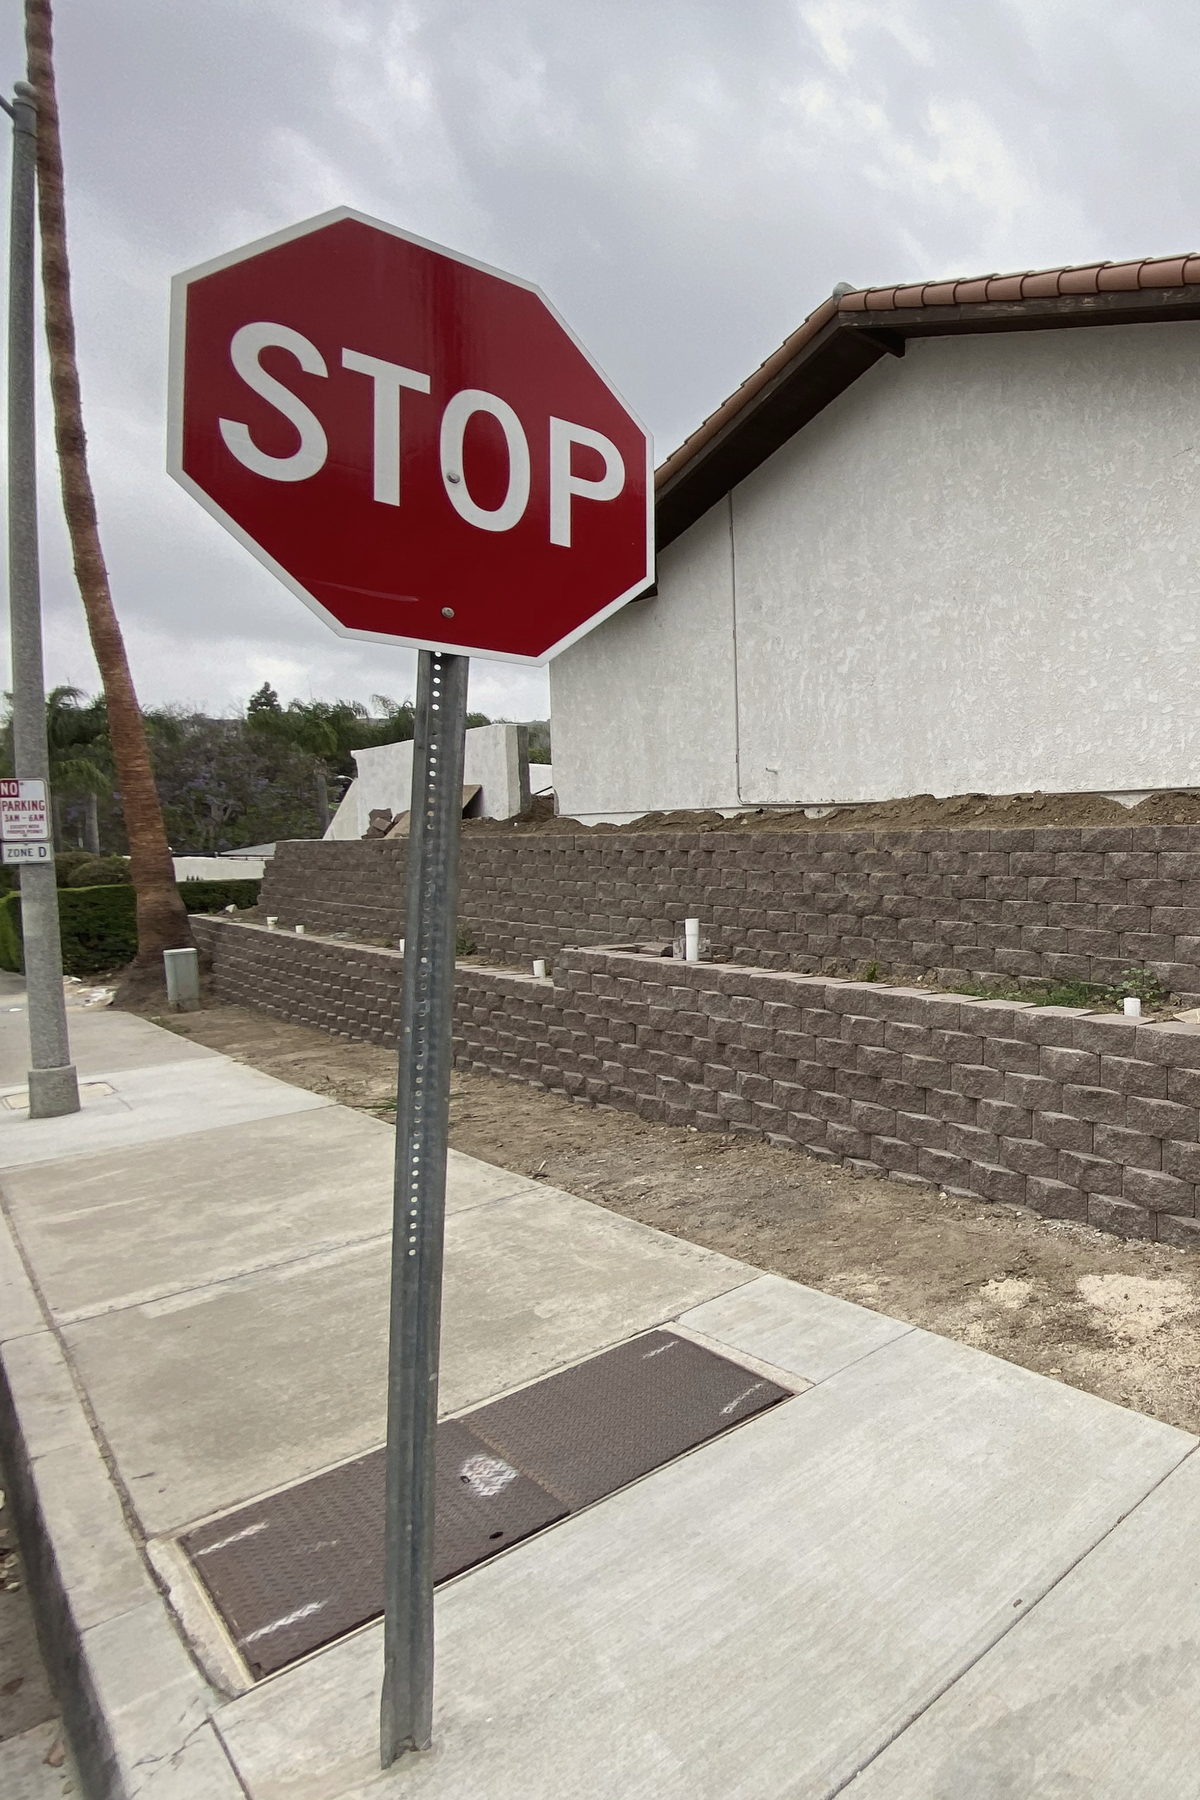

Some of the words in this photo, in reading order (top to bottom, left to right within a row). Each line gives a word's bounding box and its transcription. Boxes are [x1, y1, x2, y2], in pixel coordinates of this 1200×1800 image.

[218, 321, 626, 548] STOP
[0, 782, 18, 796] NO
[2, 800, 45, 812] PARKING
[7, 848, 34, 858] ZONE
[38, 846, 47, 858] D
